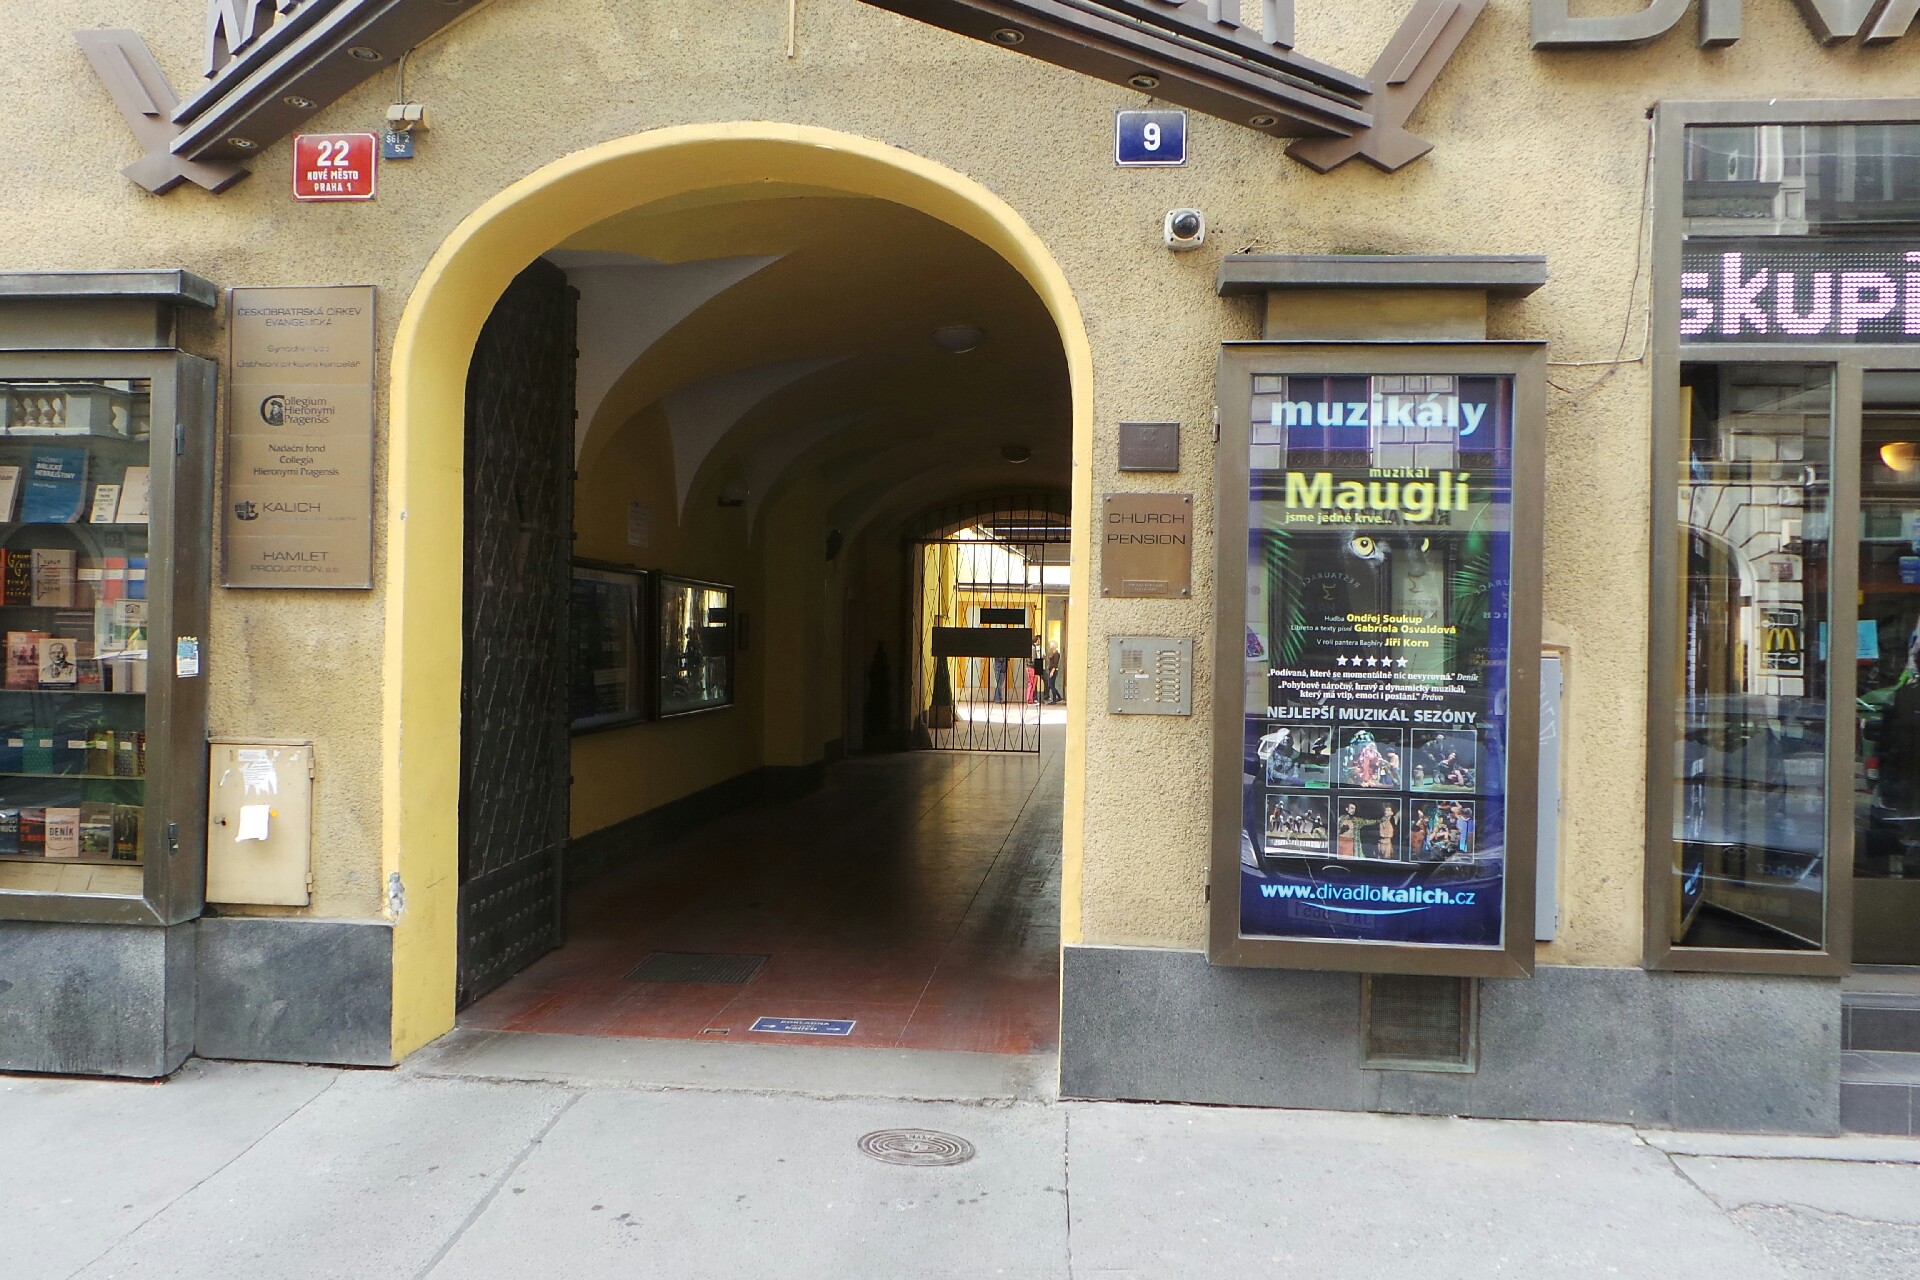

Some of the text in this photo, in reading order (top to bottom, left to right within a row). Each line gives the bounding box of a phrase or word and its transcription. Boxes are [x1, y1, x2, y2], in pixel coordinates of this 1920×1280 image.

[1143, 122, 1161, 151] 9
[316, 140, 350, 167] 22
[307, 167, 359, 180] NOVÉ MĚSTO
[314, 182, 352, 192] PRAHA 1
[1272, 392, 1488, 436] muzikály
[269, 444, 326, 452] Nadační fond
[280, 456, 314, 465] Collegia
[254, 468, 339, 478] Hieronymi Pragensis
[1369, 466, 1430, 478] muzikál
[1286, 470, 1470, 522] Mauglí
[263, 502, 320, 512] KALICH
[1109, 513, 1184, 524] CHURCH
[1285, 512, 1314, 524] jsme
[1317, 512, 1352, 524] jedné
[1107, 534, 1186, 545] PENSION
[264, 552, 328, 561] HAMLET
[1346, 614, 1380, 624] Ondřej
[1383, 614, 1422, 625] Soukup
[1354, 624, 1398, 633] Gabriela
[1400, 624, 1456, 634] Osvaldová
[1384, 638, 1400, 647] Jiří
[1403, 639, 1429, 648] Korn
[1310, 669, 1331, 678] které
[1342, 671, 1392, 679] momentálně
[1394, 672, 1406, 680] nic
[1456, 673, 1478, 681] Deník
[1355, 682, 1378, 692] hravý
[1385, 683, 1429, 693] dynamický
[1431, 685, 1466, 694] muzikál,
[1300, 690, 1322, 699] který
[1323, 690, 1335, 698] má
[1337, 691, 1354, 700] vtip,
[1266, 706, 1477, 723] NEJLEPŠÍ MUZIKÁL SEZÓNY
[50, 827, 74, 836] DENÍK
[1260, 884, 1475, 904] www.divadlokalich.cz
